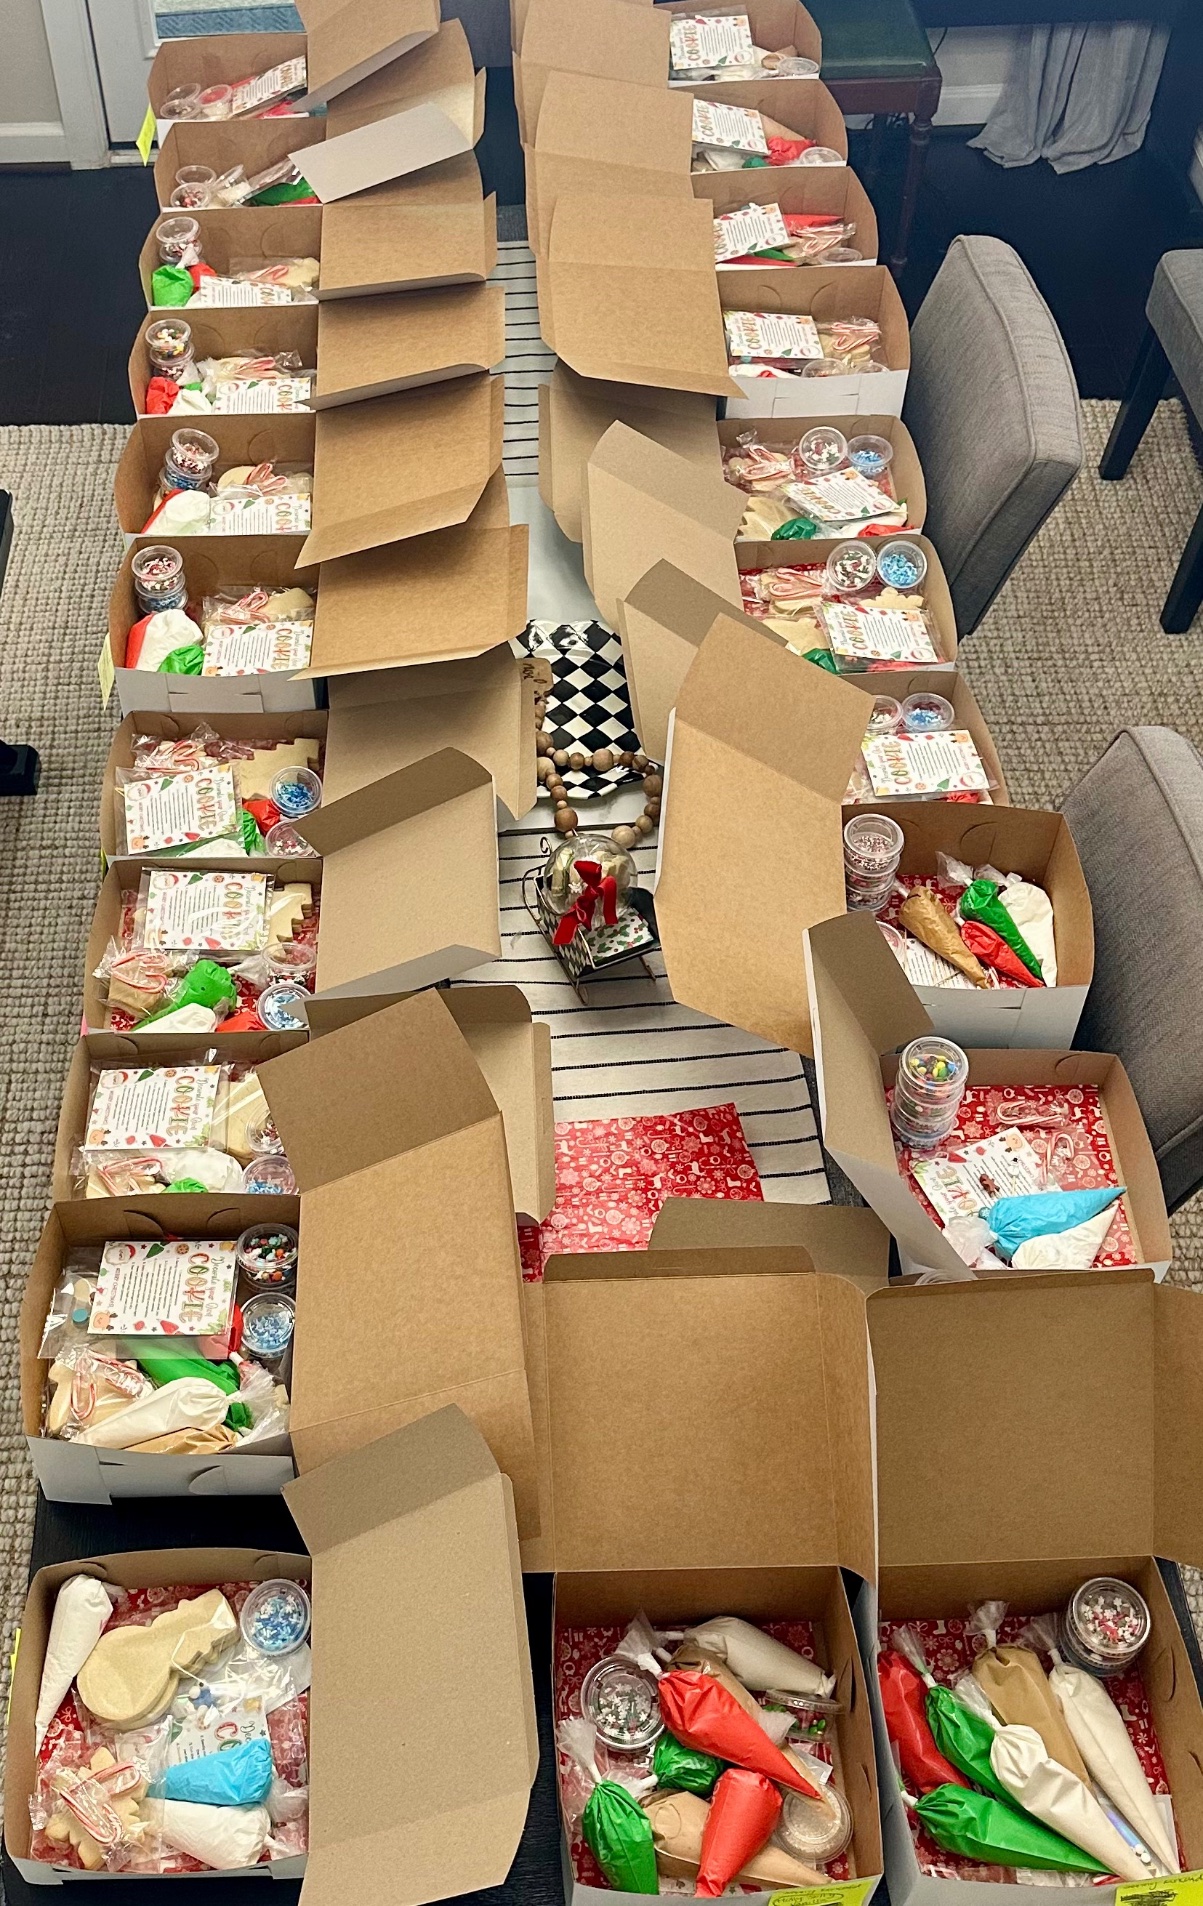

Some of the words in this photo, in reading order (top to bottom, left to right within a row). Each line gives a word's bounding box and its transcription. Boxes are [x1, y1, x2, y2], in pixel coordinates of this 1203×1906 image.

[683, 24, 701, 61] COOKIE
[695, 104, 714, 137] COOKIE
[741, 317, 762, 349] COOKIE
[277, 385, 293, 411] COOK
[270, 629, 292, 670] COOKIE
[840, 610, 868, 650] COOKIE
[882, 741, 913, 785] COOKIE
[195, 778, 217, 831] COOKIE
[166, 1076, 195, 1137] COOKIE
[935, 1166, 977, 1211] OKIE
[178, 1253, 210, 1324] COOKIE
[210, 1256, 225, 1285] Decorate
[205, 1286, 216, 1300] your
